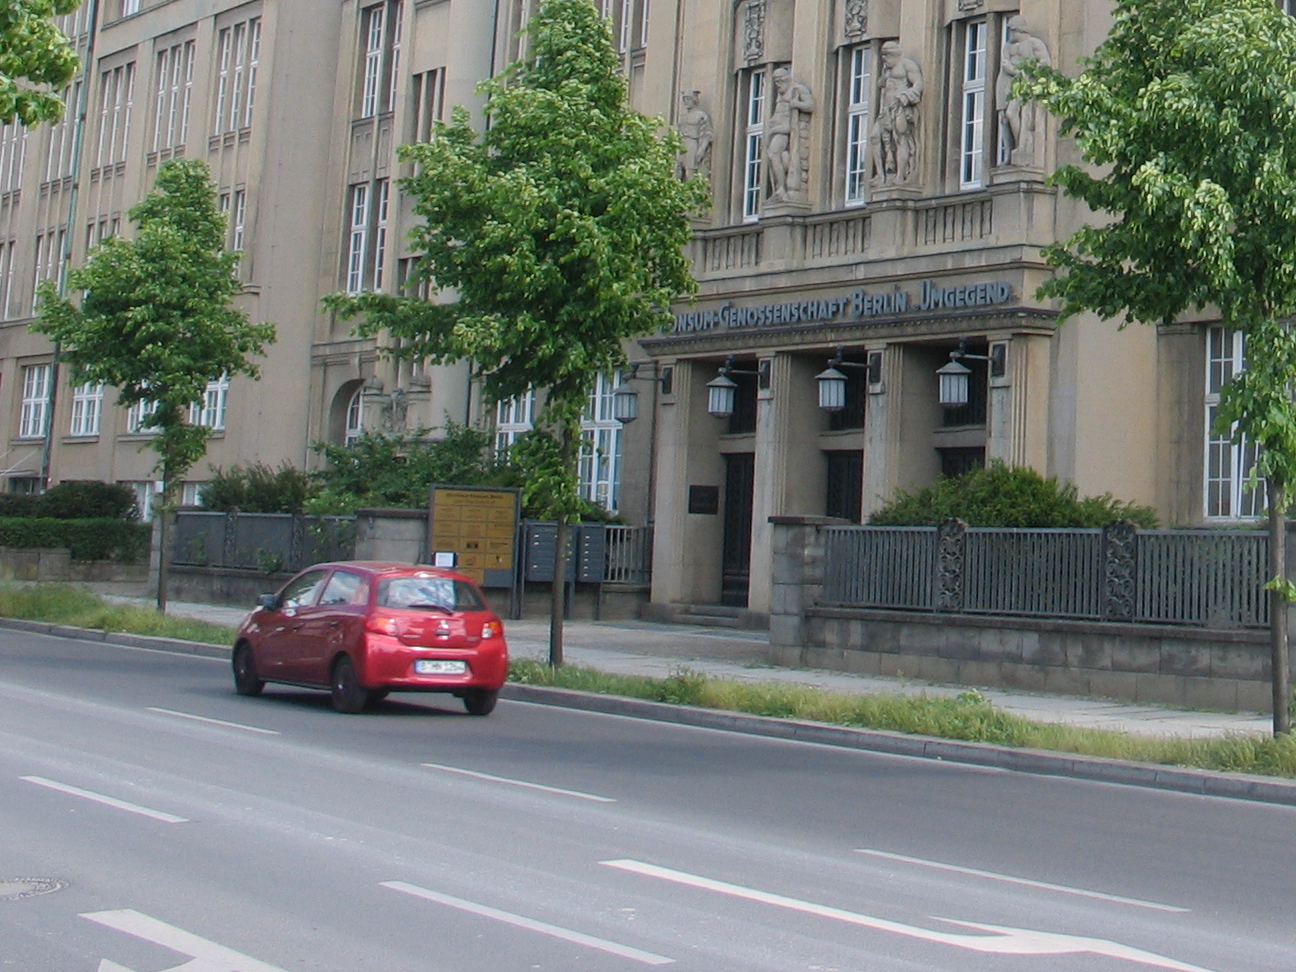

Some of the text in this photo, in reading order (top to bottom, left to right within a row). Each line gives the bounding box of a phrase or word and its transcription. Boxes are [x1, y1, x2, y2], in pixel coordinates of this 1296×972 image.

[660, 280, 1012, 332] NSUM-GENOSSENSCHAFT BERLIN UMGEGEND
